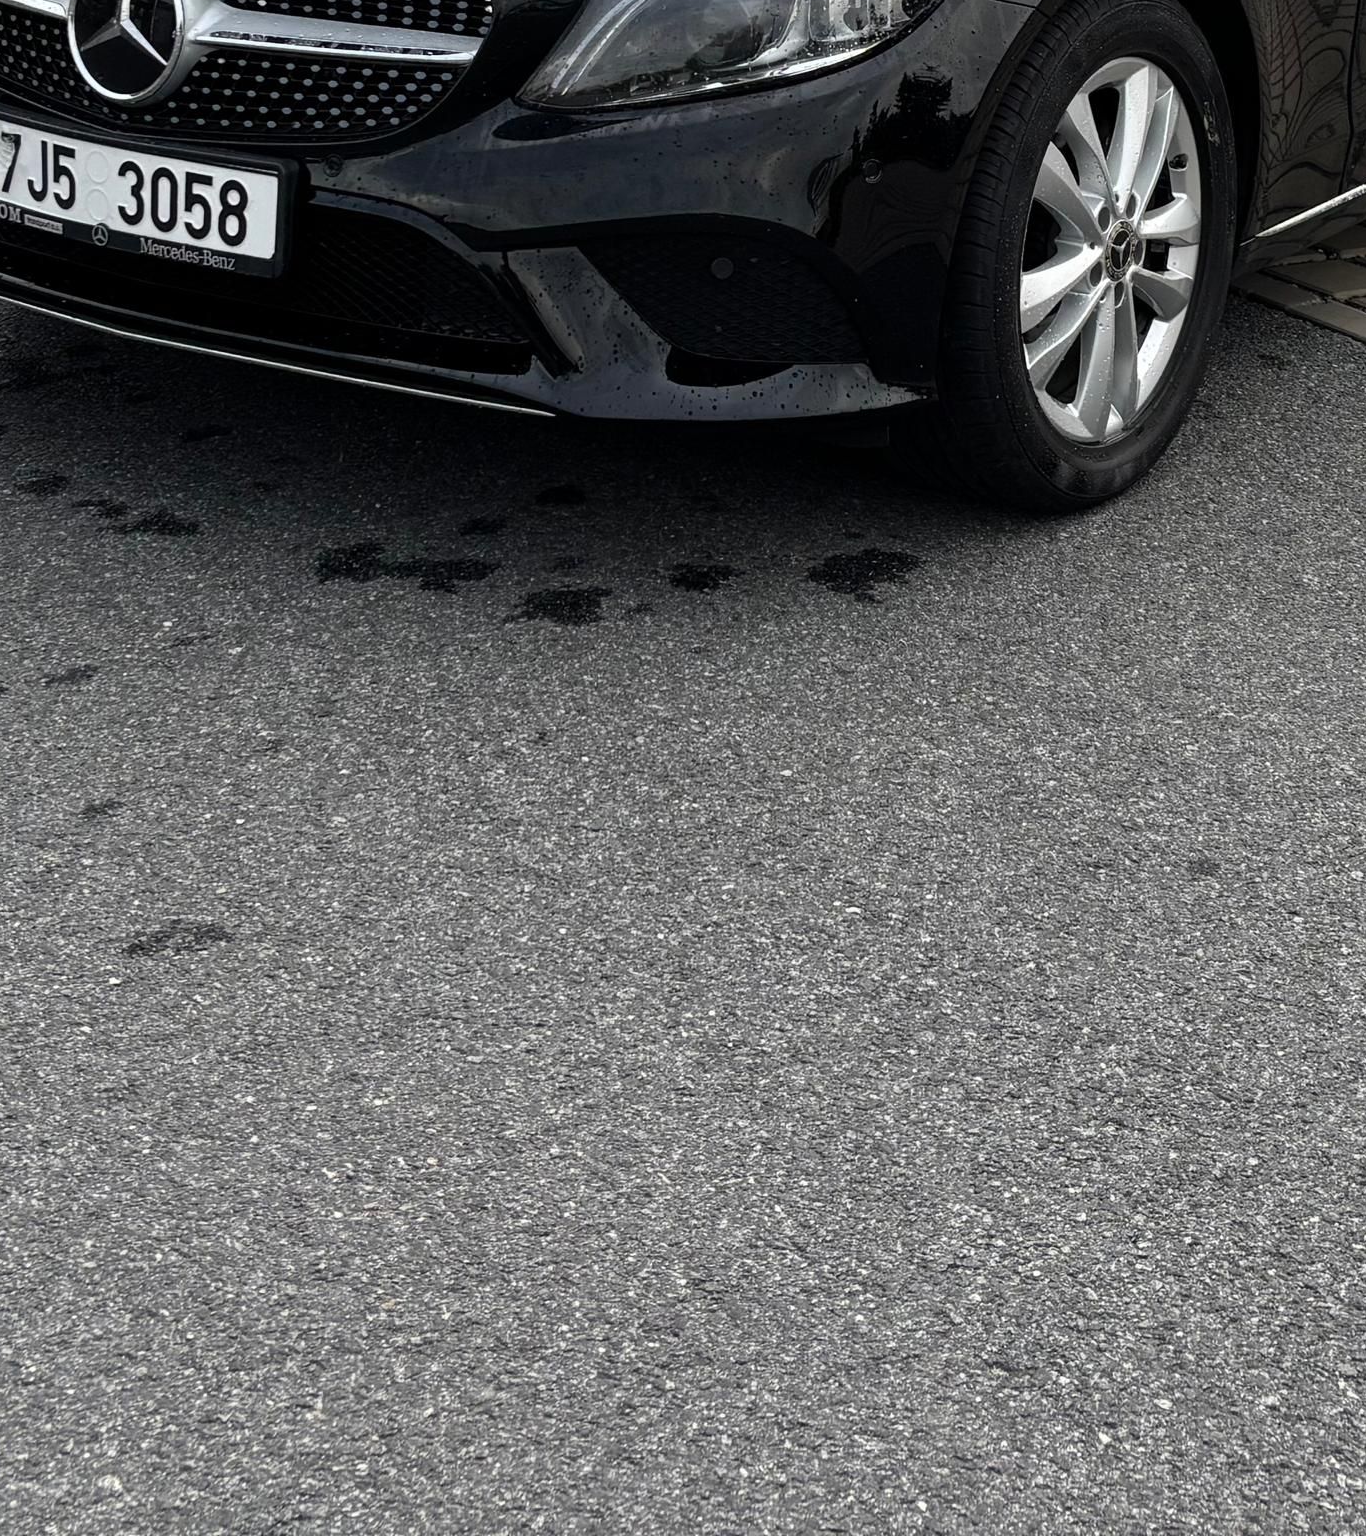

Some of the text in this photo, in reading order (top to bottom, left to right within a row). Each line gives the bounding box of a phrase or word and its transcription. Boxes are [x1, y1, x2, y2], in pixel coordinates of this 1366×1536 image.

[1, 131, 248, 246] 7J5 3058
[139, 237, 236, 271] Mercedes-Benz
